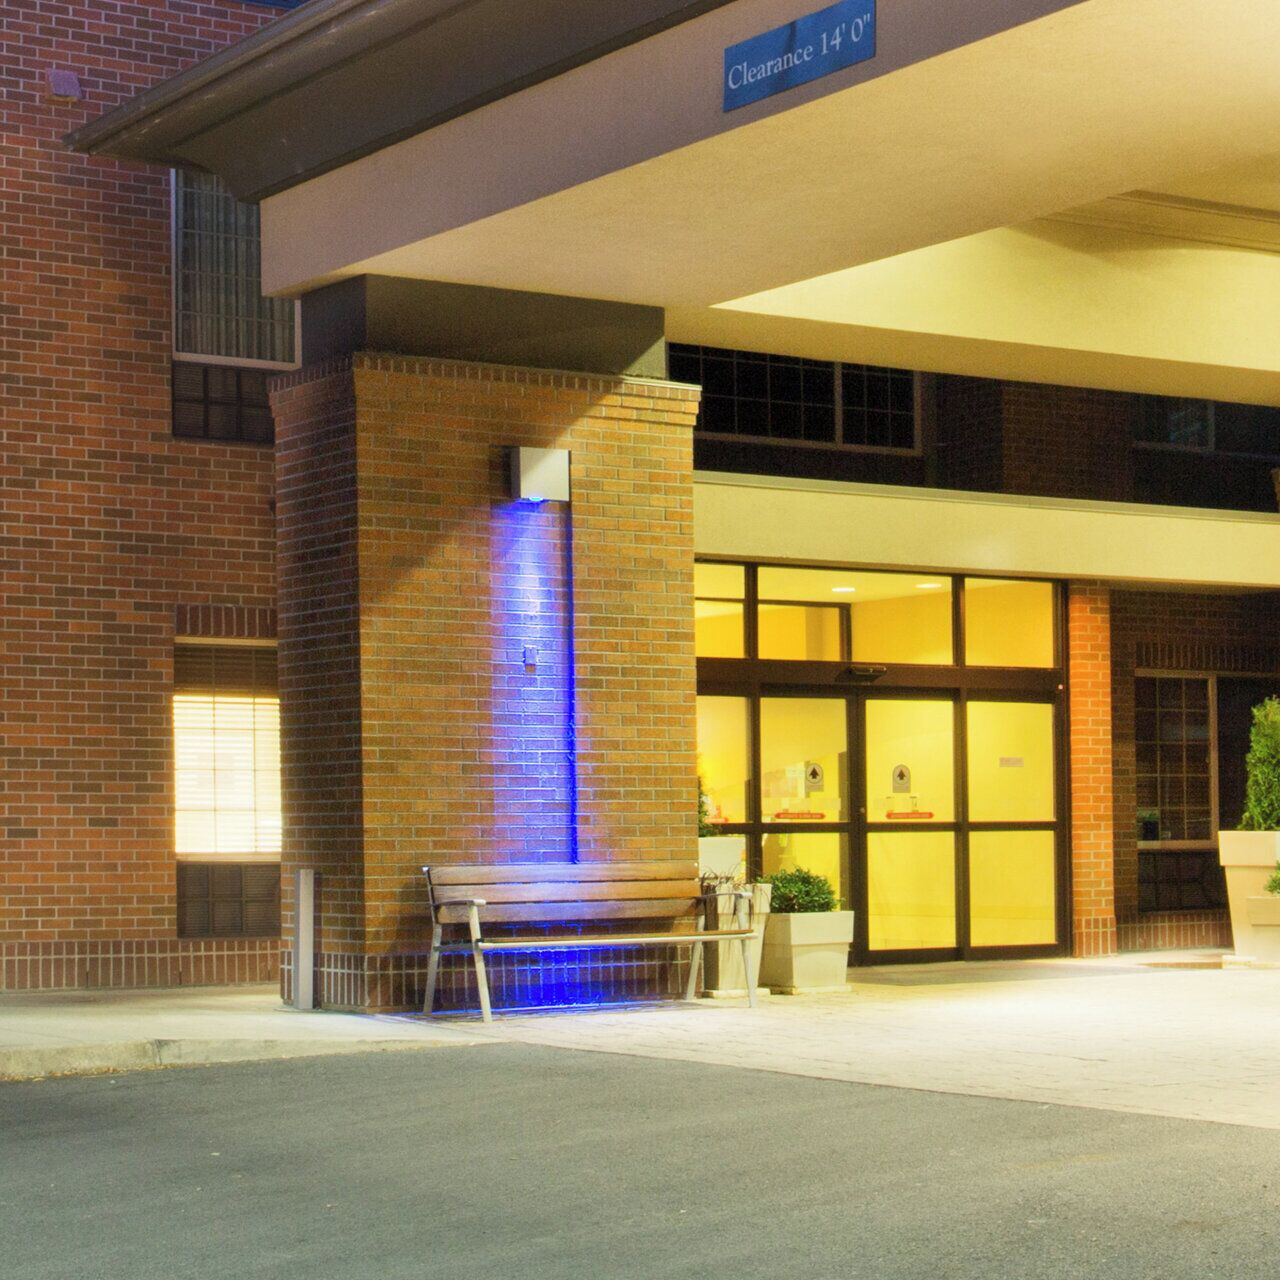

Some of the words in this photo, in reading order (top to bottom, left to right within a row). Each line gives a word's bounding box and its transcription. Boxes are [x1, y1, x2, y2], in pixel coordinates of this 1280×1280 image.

[727, 44, 814, 90] Clearance
[820, 23, 846, 56] 14'
[850, 12, 870, 43] 0"
